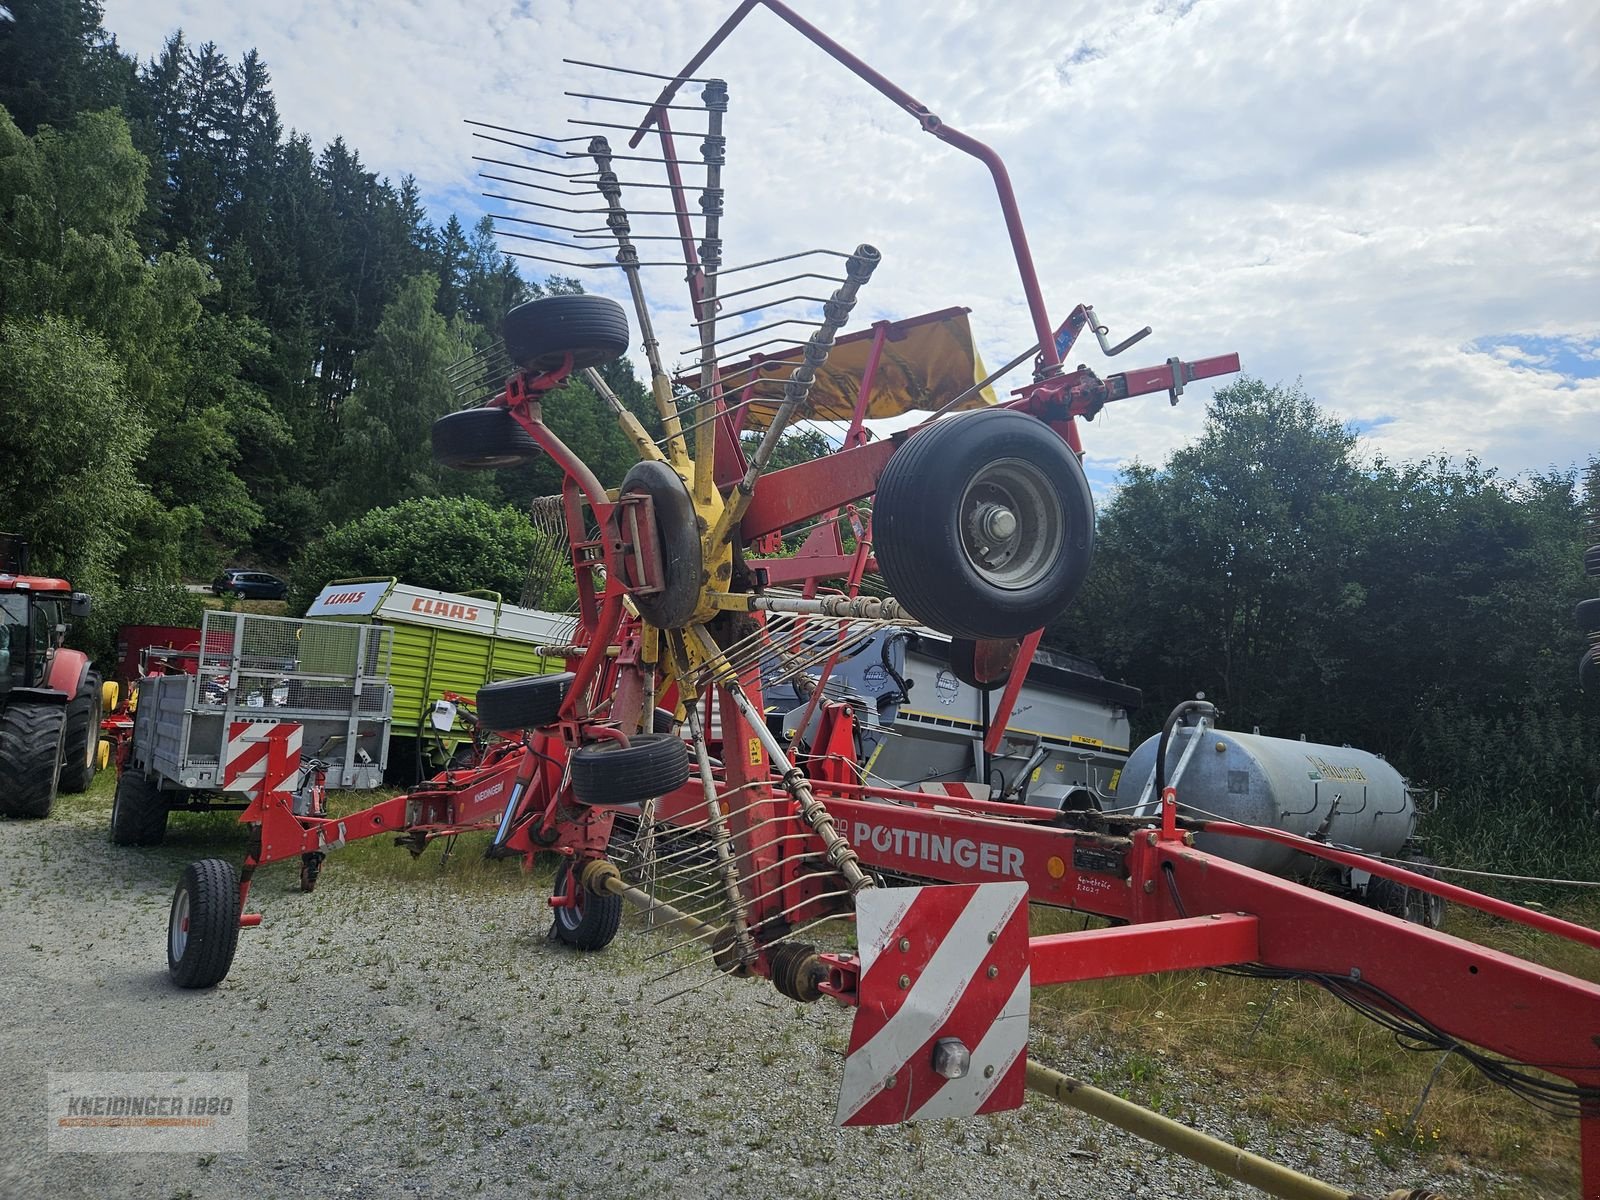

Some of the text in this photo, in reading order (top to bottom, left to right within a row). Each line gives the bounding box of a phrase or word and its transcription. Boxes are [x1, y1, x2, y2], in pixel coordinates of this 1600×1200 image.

[323, 591, 366, 606] CLAAS
[411, 597, 479, 622] CLAAS
[853, 821, 1025, 878] PÖTTINGER
